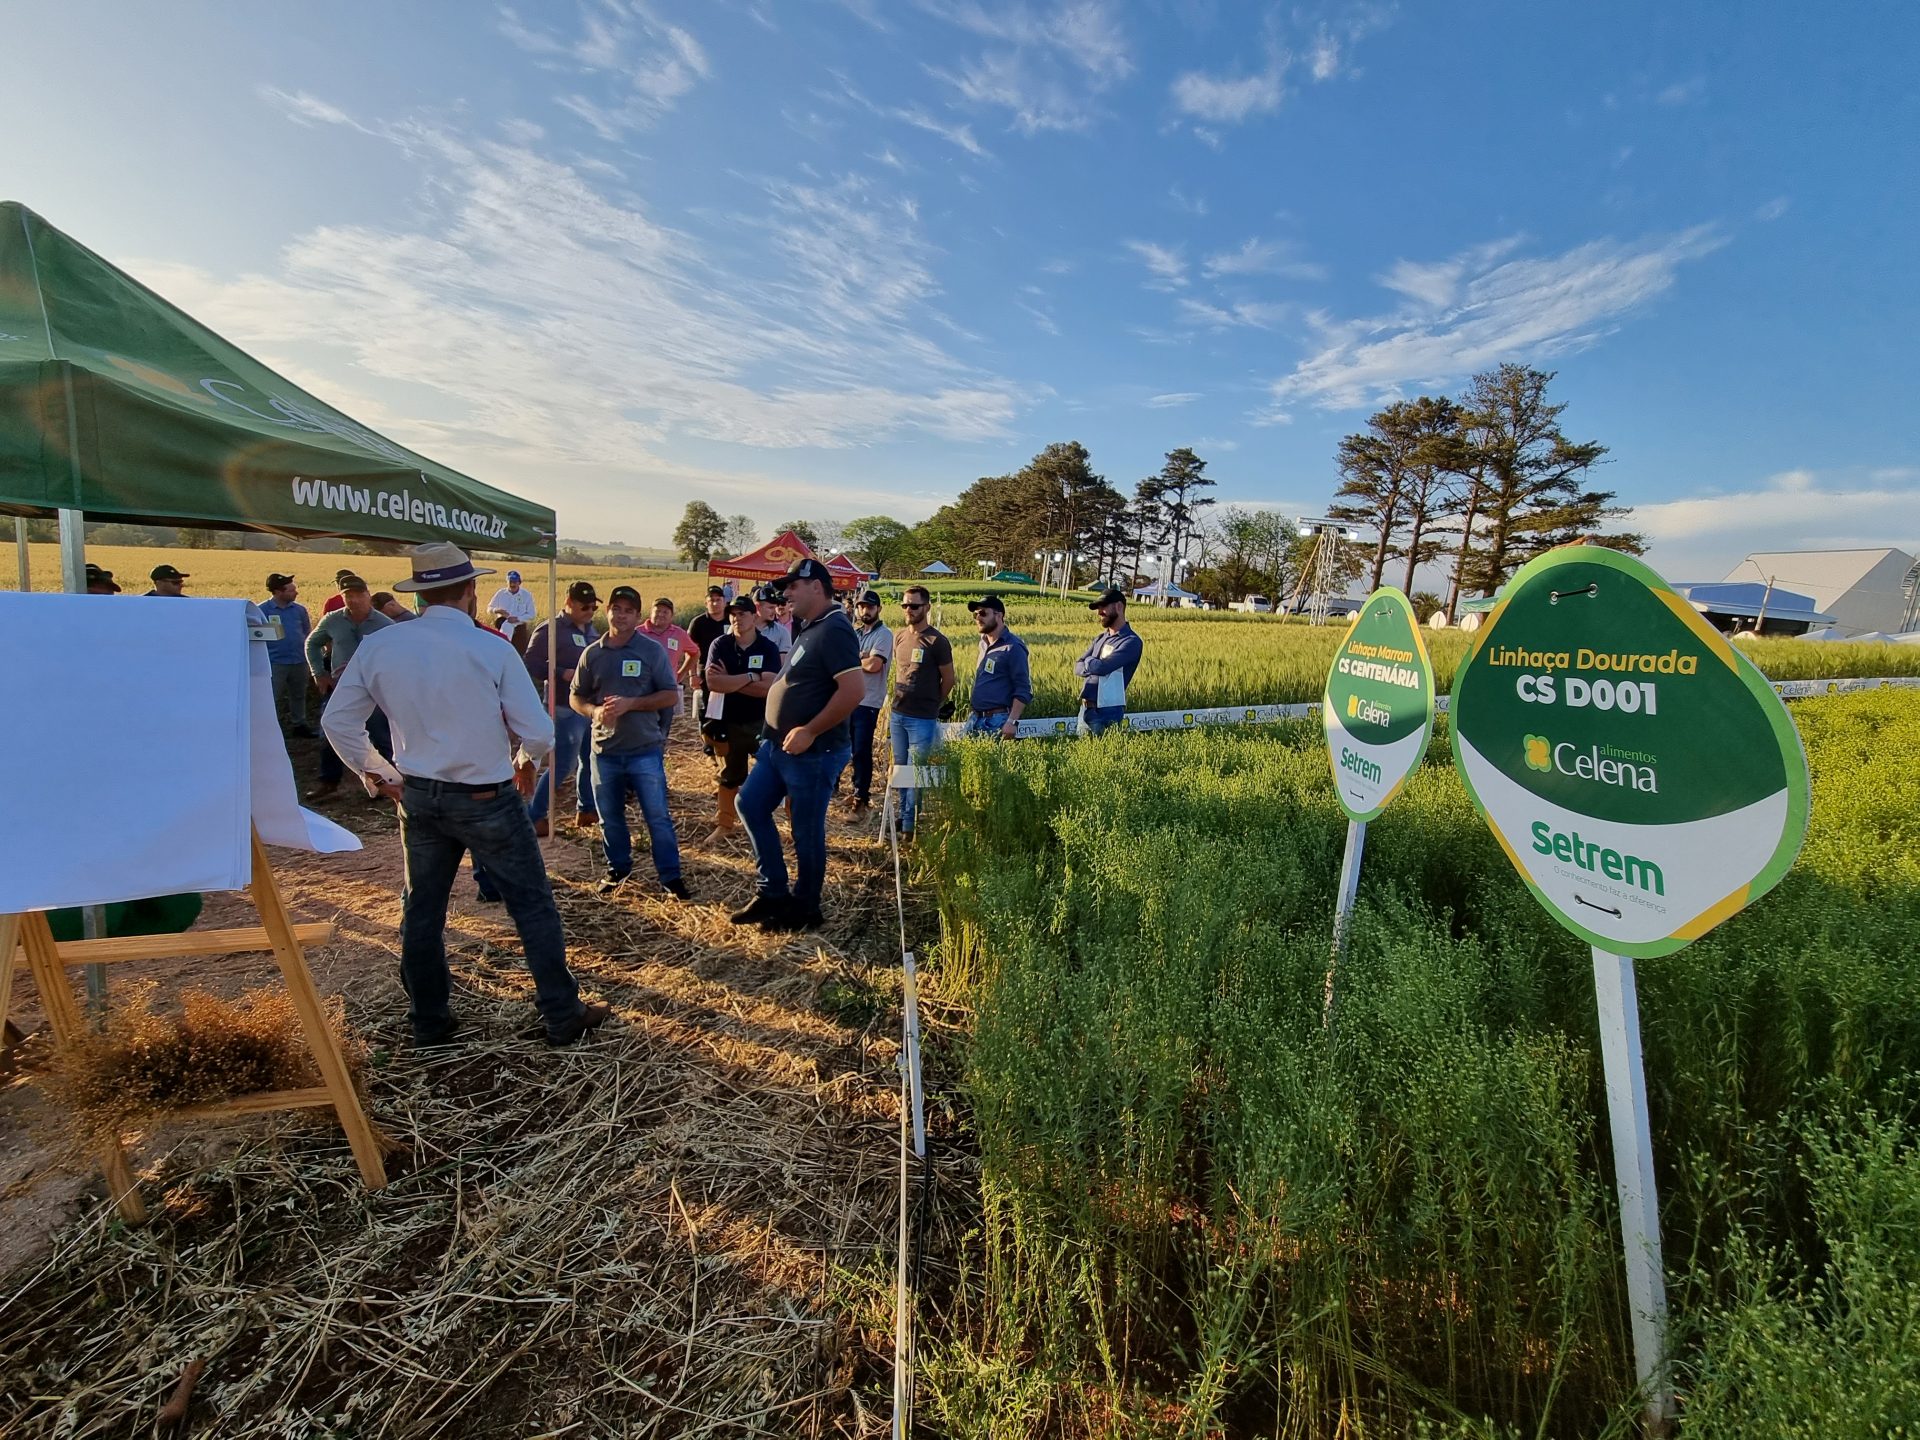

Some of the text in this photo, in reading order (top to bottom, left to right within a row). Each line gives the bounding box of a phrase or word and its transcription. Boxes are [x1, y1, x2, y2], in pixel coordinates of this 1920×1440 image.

[292, 476, 508, 540] www.celena.com.br
[1348, 641, 1413, 663] Linhaça Marrom
[1489, 645, 1698, 675] Linhaça Dourada
[1338, 657, 1420, 690] CS CENTENÁRIA
[1516, 674, 1657, 715] CS D001
[1131, 716, 1165, 728] Celena
[1357, 699, 1390, 728] Celena
[1015, 724, 1037, 735] lena
[1340, 746, 1382, 785] Setrem
[1554, 742, 1659, 794] Celena
[1600, 744, 1657, 764] alimentos
[1531, 820, 1665, 897] Setrem
